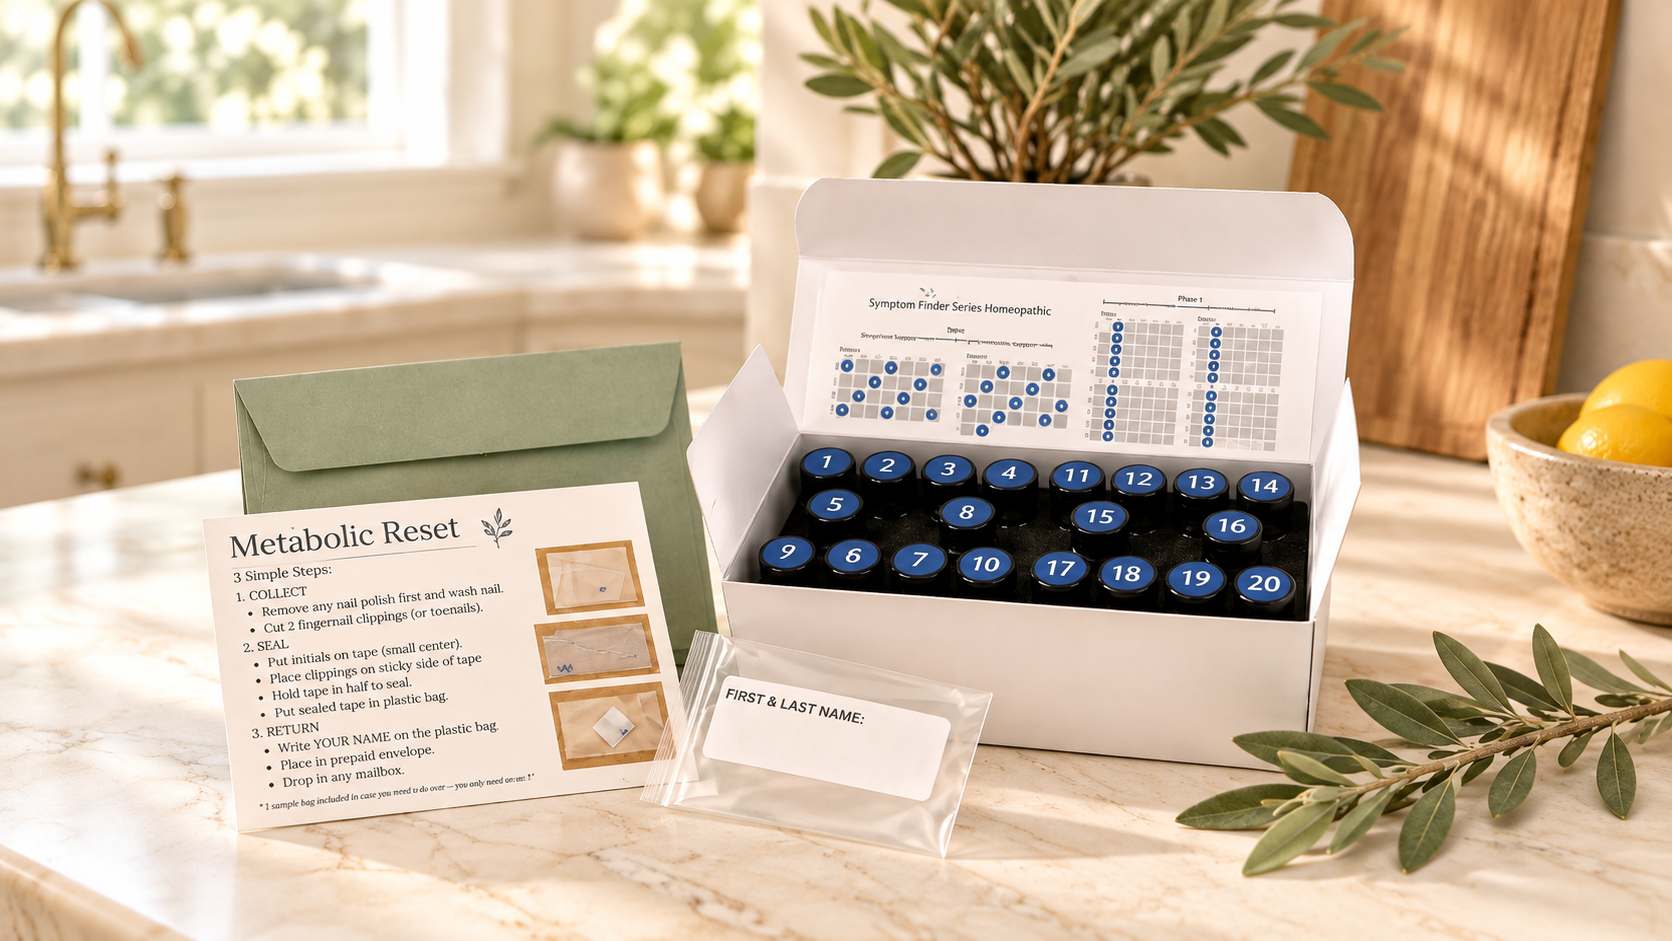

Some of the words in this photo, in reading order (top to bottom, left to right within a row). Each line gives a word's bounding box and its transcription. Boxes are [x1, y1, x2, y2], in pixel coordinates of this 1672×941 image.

[869, 298, 915, 310] Symptom
[918, 300, 950, 311] Finder
[952, 302, 982, 313] Series
[985, 304, 1051, 317] Homeopathic
[823, 455, 831, 468] 1
[879, 459, 895, 472] 2
[941, 462, 956, 476] 3
[1001, 466, 1016, 479] 4
[1066, 468, 1088, 482] 11
[1126, 472, 1152, 486] 12
[1189, 475, 1215, 489] 13
[1252, 478, 1278, 493] 14
[827, 497, 844, 511] 5
[959, 505, 975, 519] 8
[1088, 509, 1115, 524] 15
[1219, 518, 1246, 533] 16
[229, 524, 374, 558] Metabolic
[381, 518, 460, 544] Reset
[780, 544, 796, 559] 9
[846, 548, 861, 563] 6
[912, 552, 929, 567] 7
[973, 556, 1000, 572] 10
[1047, 560, 1075, 576] 17
[234, 572, 241, 583] 3
[245, 567, 289, 582] Simple
[293, 566, 332, 578] Steps:
[1113, 565, 1141, 582] 18
[1182, 570, 1210, 586] 19
[1247, 575, 1280, 592] 20
[236, 592, 245, 602] 1.
[249, 586, 307, 601] COLLECT
[262, 605, 309, 617] Remove
[312, 603, 333, 613] any
[336, 598, 358, 609] nail
[360, 594, 396, 610] polish
[398, 592, 422, 603] first
[425, 589, 446, 600] and
[448, 586, 478, 597] wash
[480, 584, 503, 595] nail.
[264, 623, 285, 633] Cut
[288, 621, 295, 631] 2
[298, 614, 353, 631] fingernail
[356, 611, 408, 625] clippings
[411, 608, 427, 621] (or
[430, 602, 483, 617] toenails).
[243, 643, 254, 653] 2.
[257, 639, 289, 651] SEAL
[268, 657, 289, 667] Put
[291, 652, 331, 665] initials
[334, 652, 349, 660] on
[352, 649, 378, 660] tape
[381, 643, 416, 658] (small
[419, 638, 462, 652] center).
[270, 672, 301, 684] Place
[305, 668, 357, 682] clippings
[360, 666, 376, 675] on
[379, 660, 412, 673] sticky
[416, 657, 439, 669] side
[442, 655, 455, 666] of
[457, 655, 482, 666] tape
[272, 688, 300, 701] Hold
[303, 688, 331, 699] tape
[332, 685, 343, 695] in
[346, 680, 369, 693] half
[371, 682, 383, 690] to
[386, 676, 412, 689] seal.
[275, 707, 296, 718] Put
[299, 701, 337, 715] sealed
[339, 701, 365, 712] tape
[368, 698, 380, 708] in
[383, 694, 421, 709] plastic
[424, 692, 448, 704] bag.
[726, 688, 766, 704] FIRST
[767, 696, 777, 707] &
[780, 698, 817, 714] LAST
[819, 706, 864, 724] NAME:
[252, 728, 263, 739] 3.
[266, 722, 319, 737] RETURN
[277, 742, 311, 753] Write
[313, 736, 350, 749] YOUR
[353, 732, 391, 745] NAME
[394, 732, 409, 740] on
[412, 728, 431, 738] the
[434, 724, 472, 739] plastic
[475, 722, 499, 733] bag.
[281, 759, 312, 770] Place
[315, 756, 327, 767] in
[330, 750, 376, 768] prepaid
[379, 746, 434, 760] envelope.
[283, 777, 313, 788] Drop
[316, 773, 328, 784] in
[331, 773, 352, 783] any
[355, 766, 404, 779] mailbox.
[271, 800, 299, 810] sample
[301, 798, 315, 807] bag
[317, 794, 350, 805] included
[351, 793, 359, 801] in
[360, 793, 377, 801] case
[378, 790, 392, 799] you
[393, 786, 411, 795] need
[420, 785, 428, 793] do
[430, 784, 445, 792] over
[455, 782, 468, 791] you
[469, 780, 485, 788] only
[486, 776, 503, 785] need
